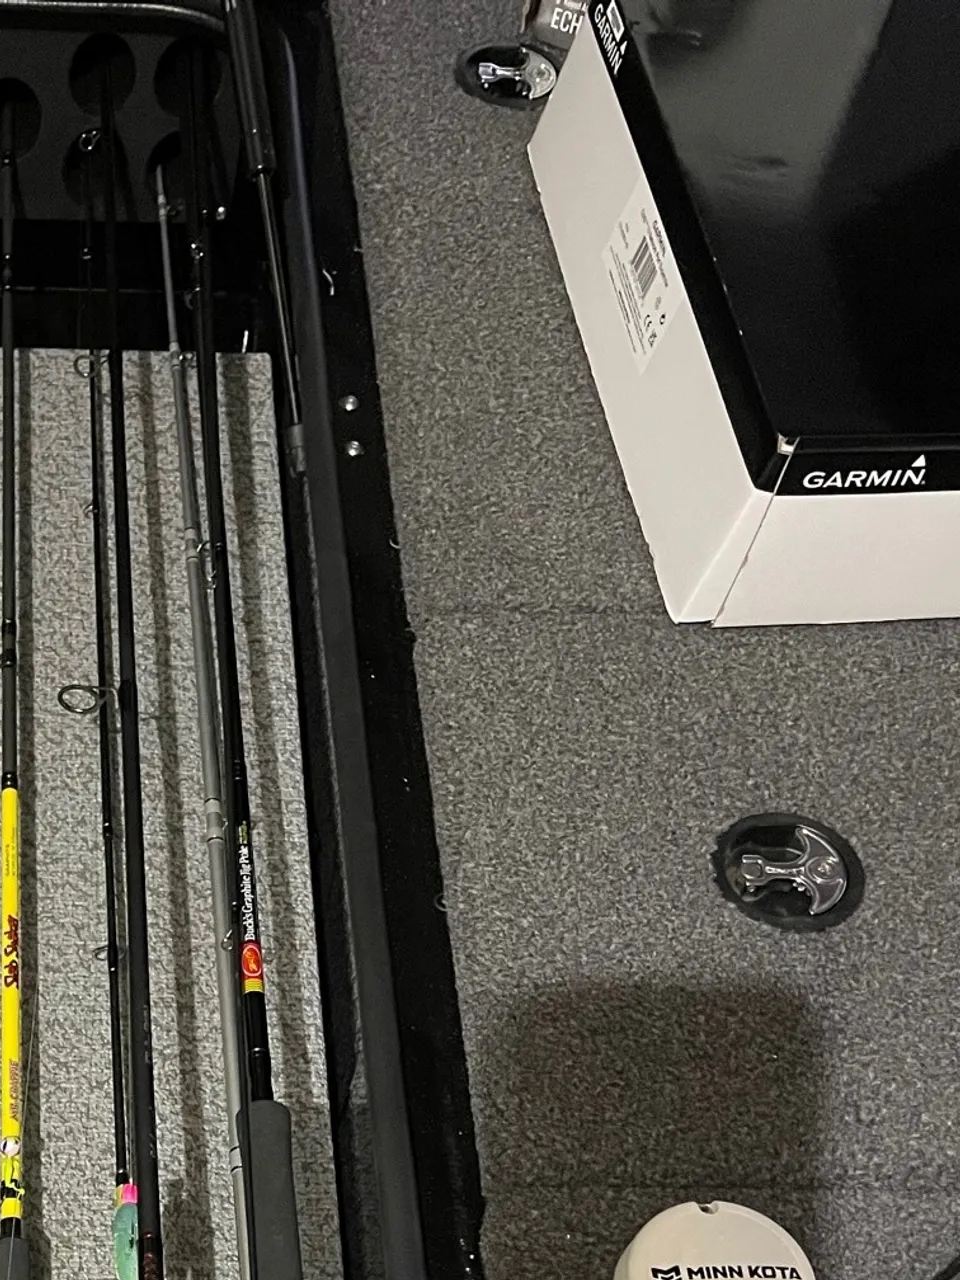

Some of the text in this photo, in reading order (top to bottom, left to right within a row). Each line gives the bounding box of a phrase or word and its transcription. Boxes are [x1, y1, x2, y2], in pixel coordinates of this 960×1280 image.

[595, 3, 623, 75] GARMIN
[802, 468, 926, 489] GARMIN
[238, 845, 250, 864] Pole
[240, 875, 255, 913] Graphite
[243, 912, 256, 941] Buck's
[686, 1265, 803, 1280] MINN KOTA
